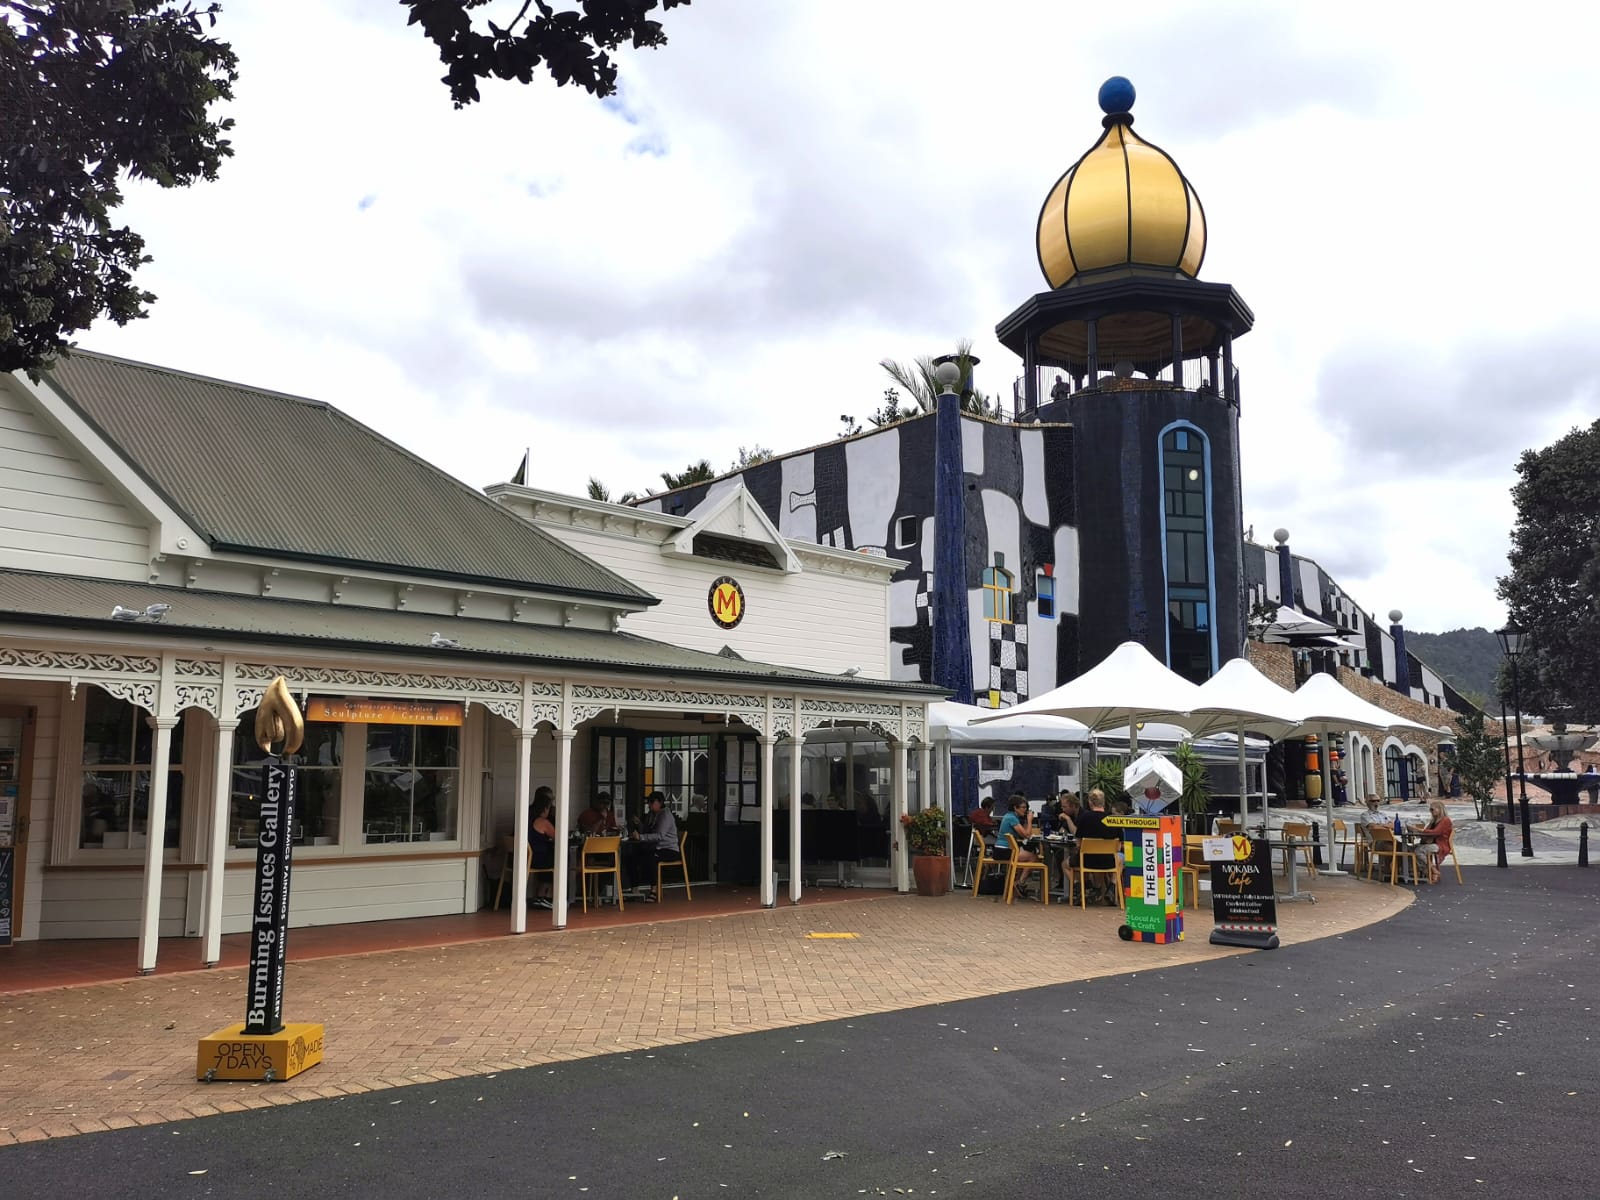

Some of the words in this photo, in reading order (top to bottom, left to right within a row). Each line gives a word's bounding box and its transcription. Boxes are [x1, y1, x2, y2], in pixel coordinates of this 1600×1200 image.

[717, 588, 737, 616] M
[324, 708, 384, 719] Sculpture
[401, 711, 449, 721] Ceramics
[260, 765, 286, 848] Gallery
[284, 806, 293, 860] CERAMICS
[1145, 839, 1155, 871] BACH
[1164, 842, 1172, 896] GALLERY
[1222, 864, 1260, 874] MOKABA
[255, 853, 276, 925] Issues
[281, 865, 289, 920] PAINTINGS
[1146, 875, 1156, 898] THE
[1131, 914, 1149, 922] Local
[1138, 922, 1156, 930] Craft
[248, 930, 276, 1026] Burning
[275, 965, 283, 1018] JEWELLERY
[213, 1056, 221, 1069] 7
[227, 1056, 273, 1070] DAYS
[218, 1043, 265, 1057] OPEN
